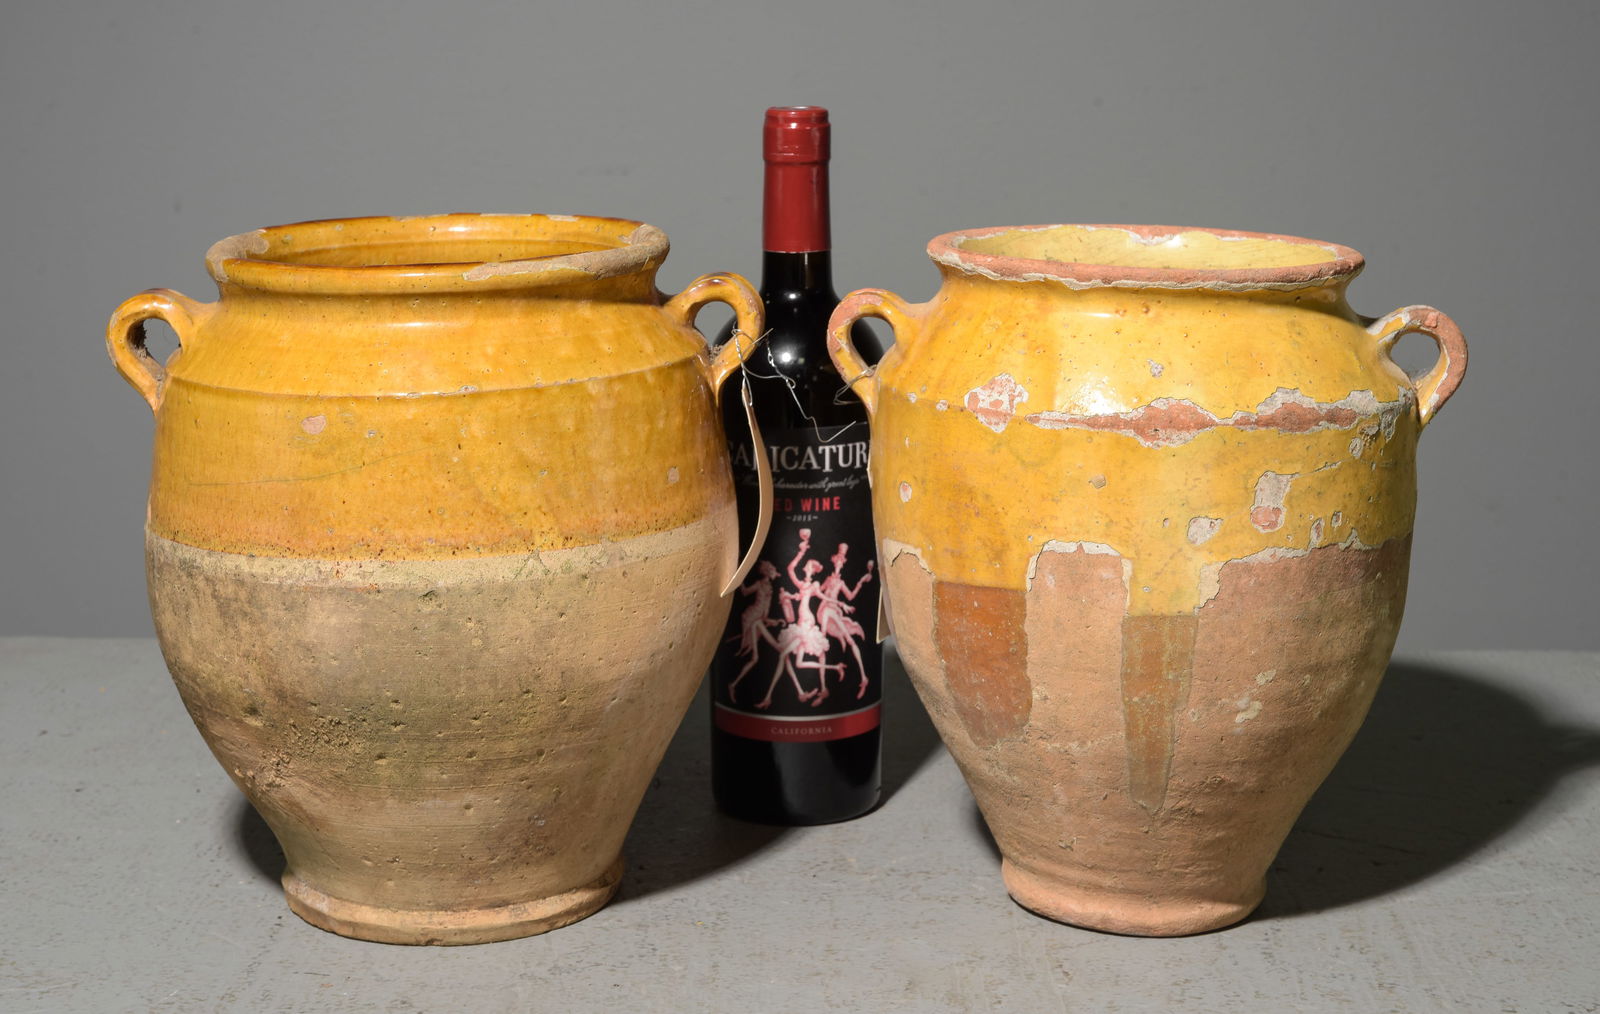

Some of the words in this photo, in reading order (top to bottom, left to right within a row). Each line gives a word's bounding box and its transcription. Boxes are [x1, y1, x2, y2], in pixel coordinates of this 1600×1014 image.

[727, 440, 867, 472] AICATUR
[775, 477, 807, 489] haracter
[775, 497, 793, 512] ED
[801, 496, 840, 512] WINE
[771, 726, 832, 735] CALIFORNIA
